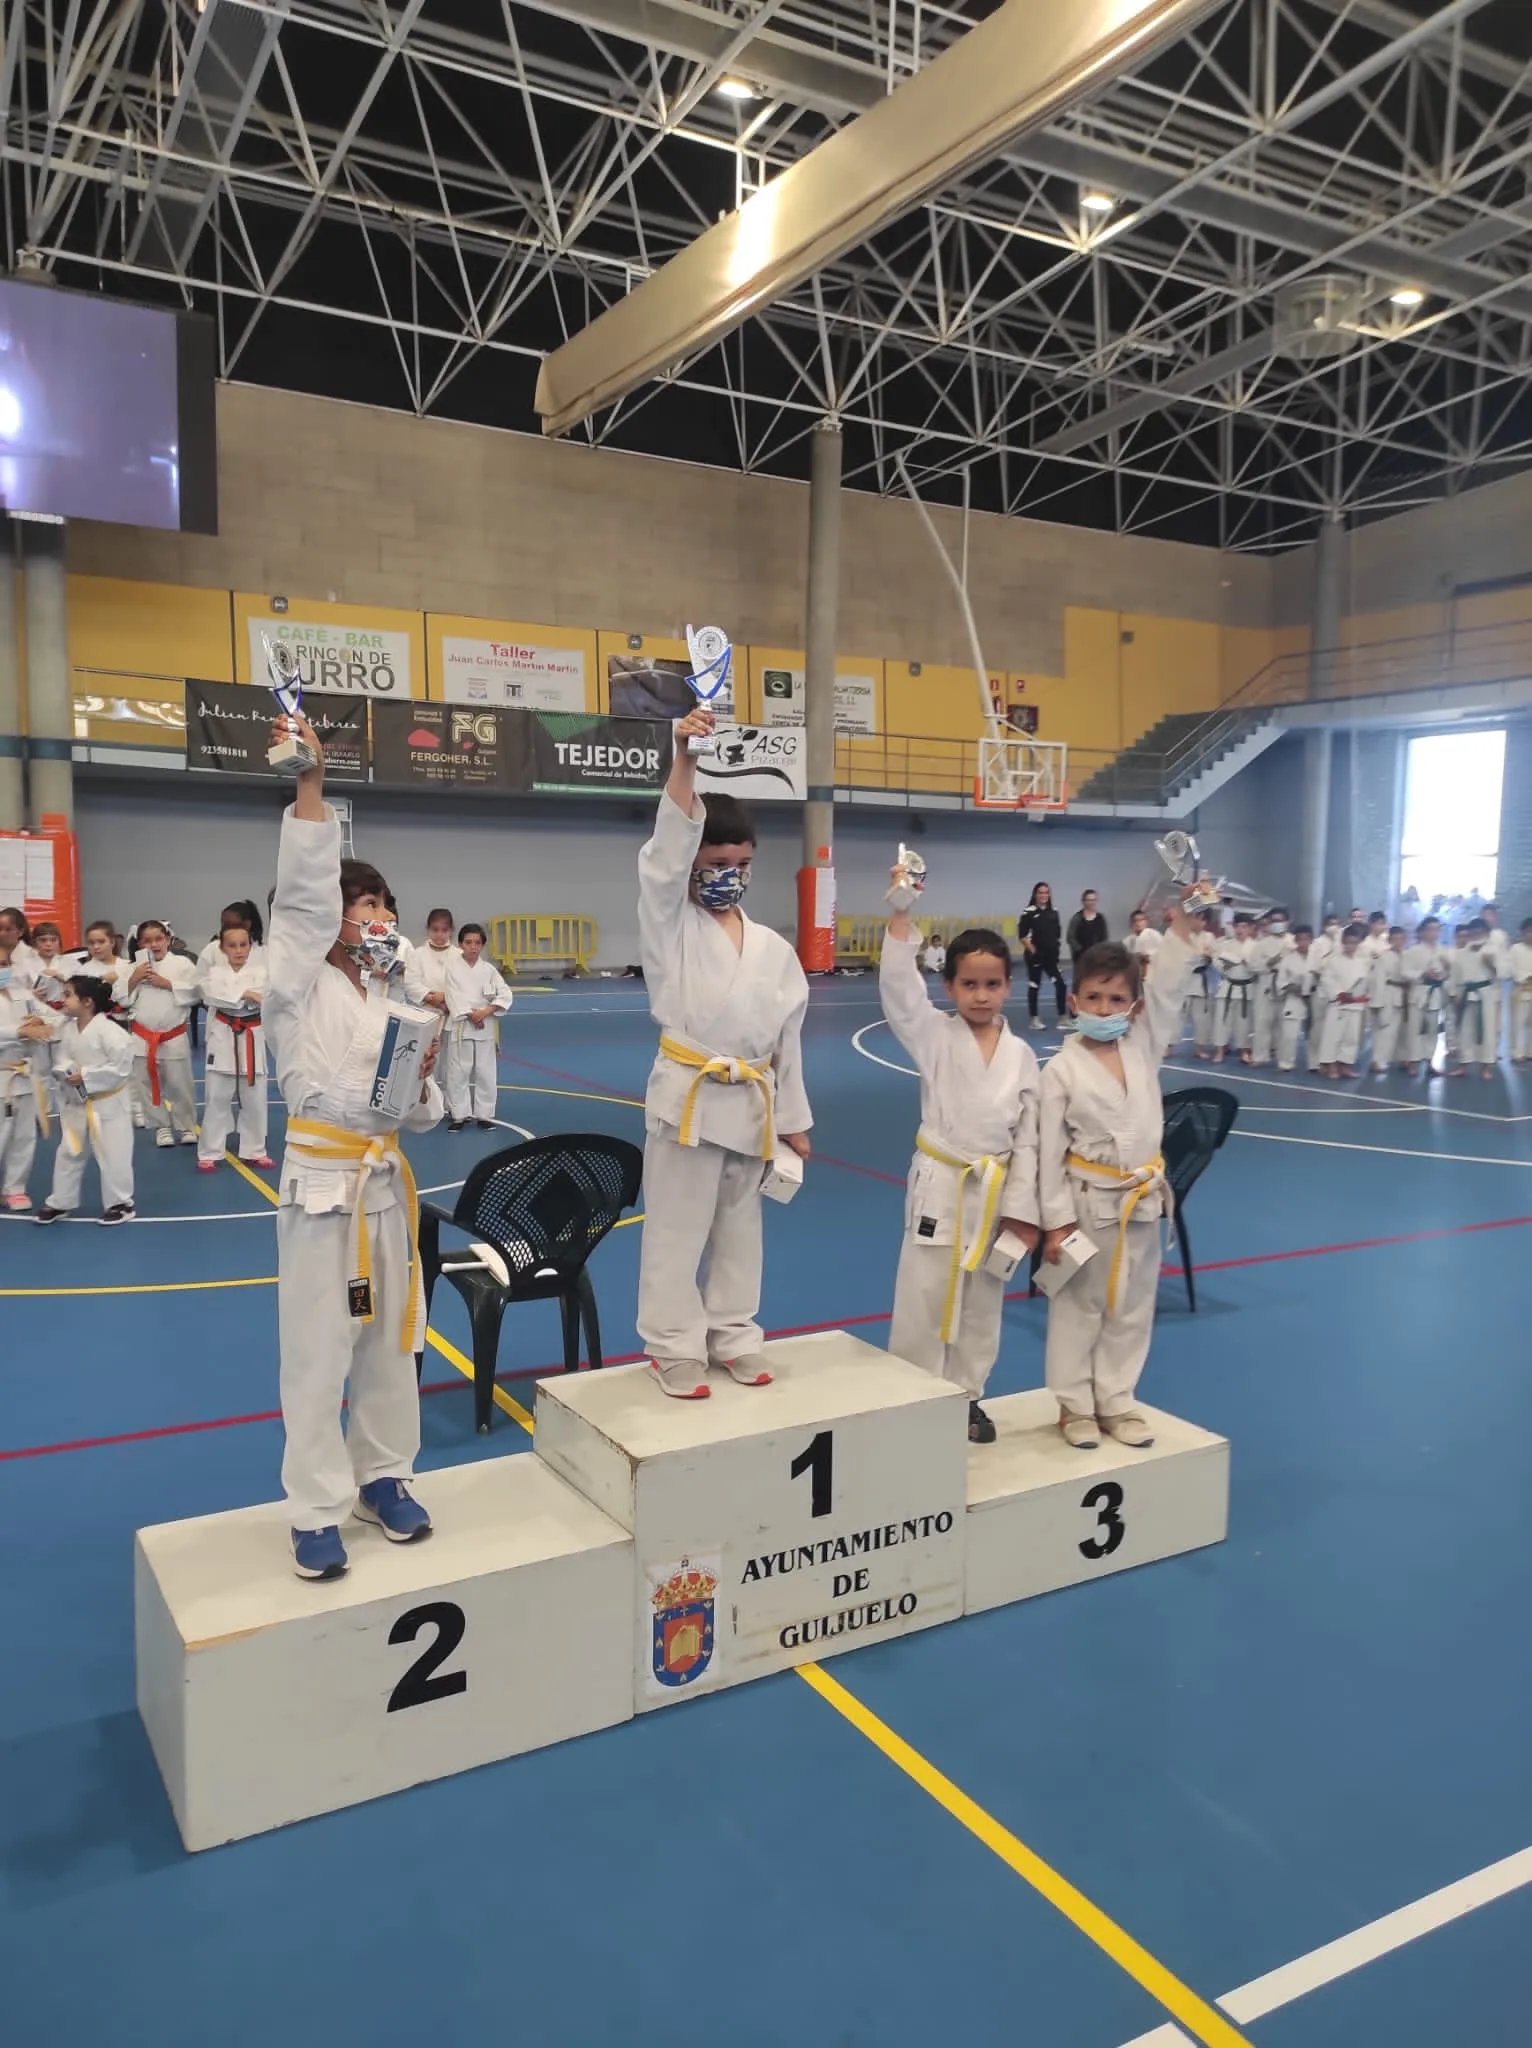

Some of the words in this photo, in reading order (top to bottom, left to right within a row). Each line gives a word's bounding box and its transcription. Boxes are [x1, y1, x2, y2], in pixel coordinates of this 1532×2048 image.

[345, 632, 383, 648] BAR
[490, 644, 536, 660] Taller
[369, 651, 391, 665] DE
[448, 654, 473, 664] Juan
[476, 656, 509, 667] Carlos
[294, 659, 395, 691] URRO
[554, 743, 660, 770] TEJEDOR
[751, 735, 797, 755] ASG
[790, 1430, 833, 1518] 1
[1078, 1481, 1125, 1560] 3
[740, 1510, 953, 1585] AYUNTAMIENTO
[832, 1568, 871, 1599] DE
[779, 1593, 918, 1650] GUIJUELO
[386, 1600, 467, 1713] 2
